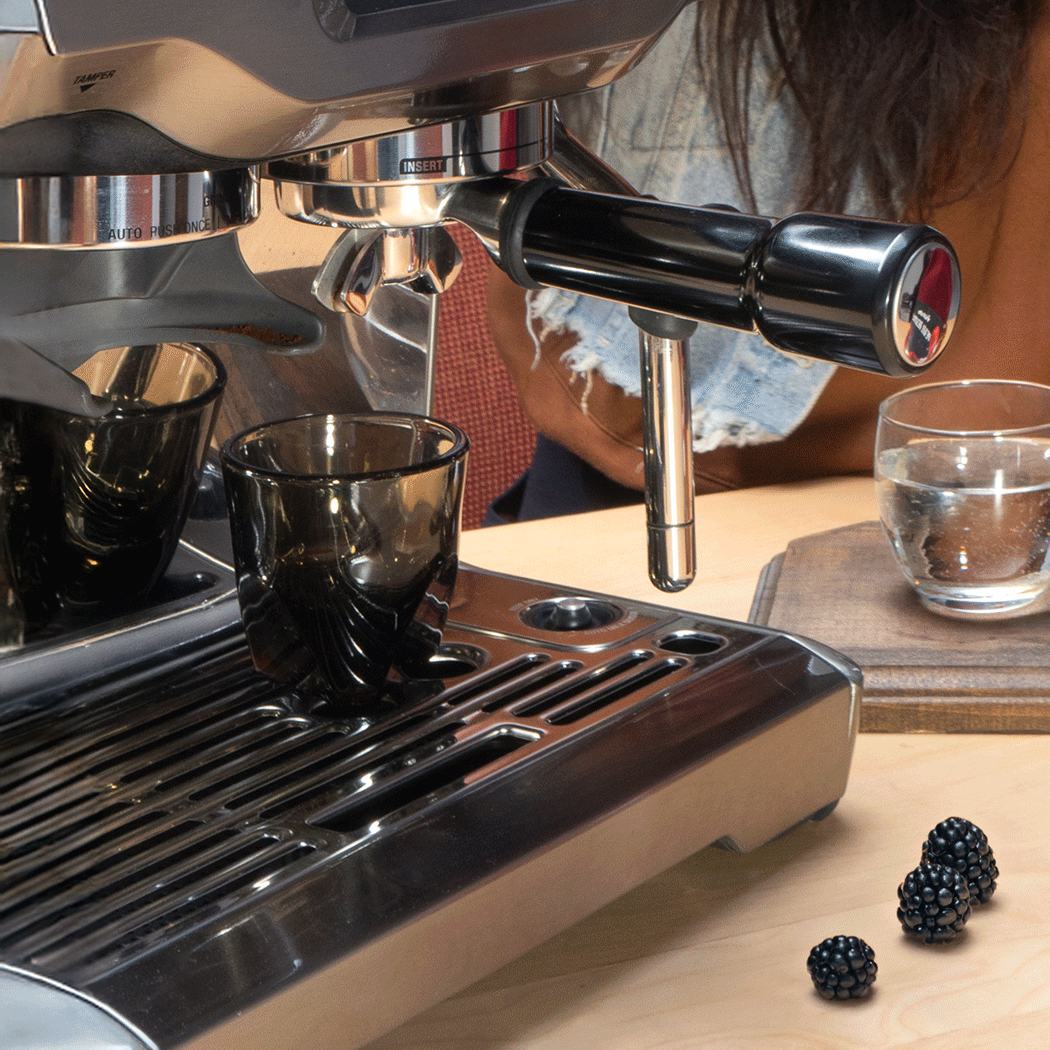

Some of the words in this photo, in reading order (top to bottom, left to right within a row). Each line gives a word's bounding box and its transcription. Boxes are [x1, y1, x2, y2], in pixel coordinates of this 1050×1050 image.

[73, 70, 116, 84] TAMPER
[403, 159, 443, 172] INSERT
[108, 228, 142, 240] AUTO
[150, 224, 180, 238] PUSH
